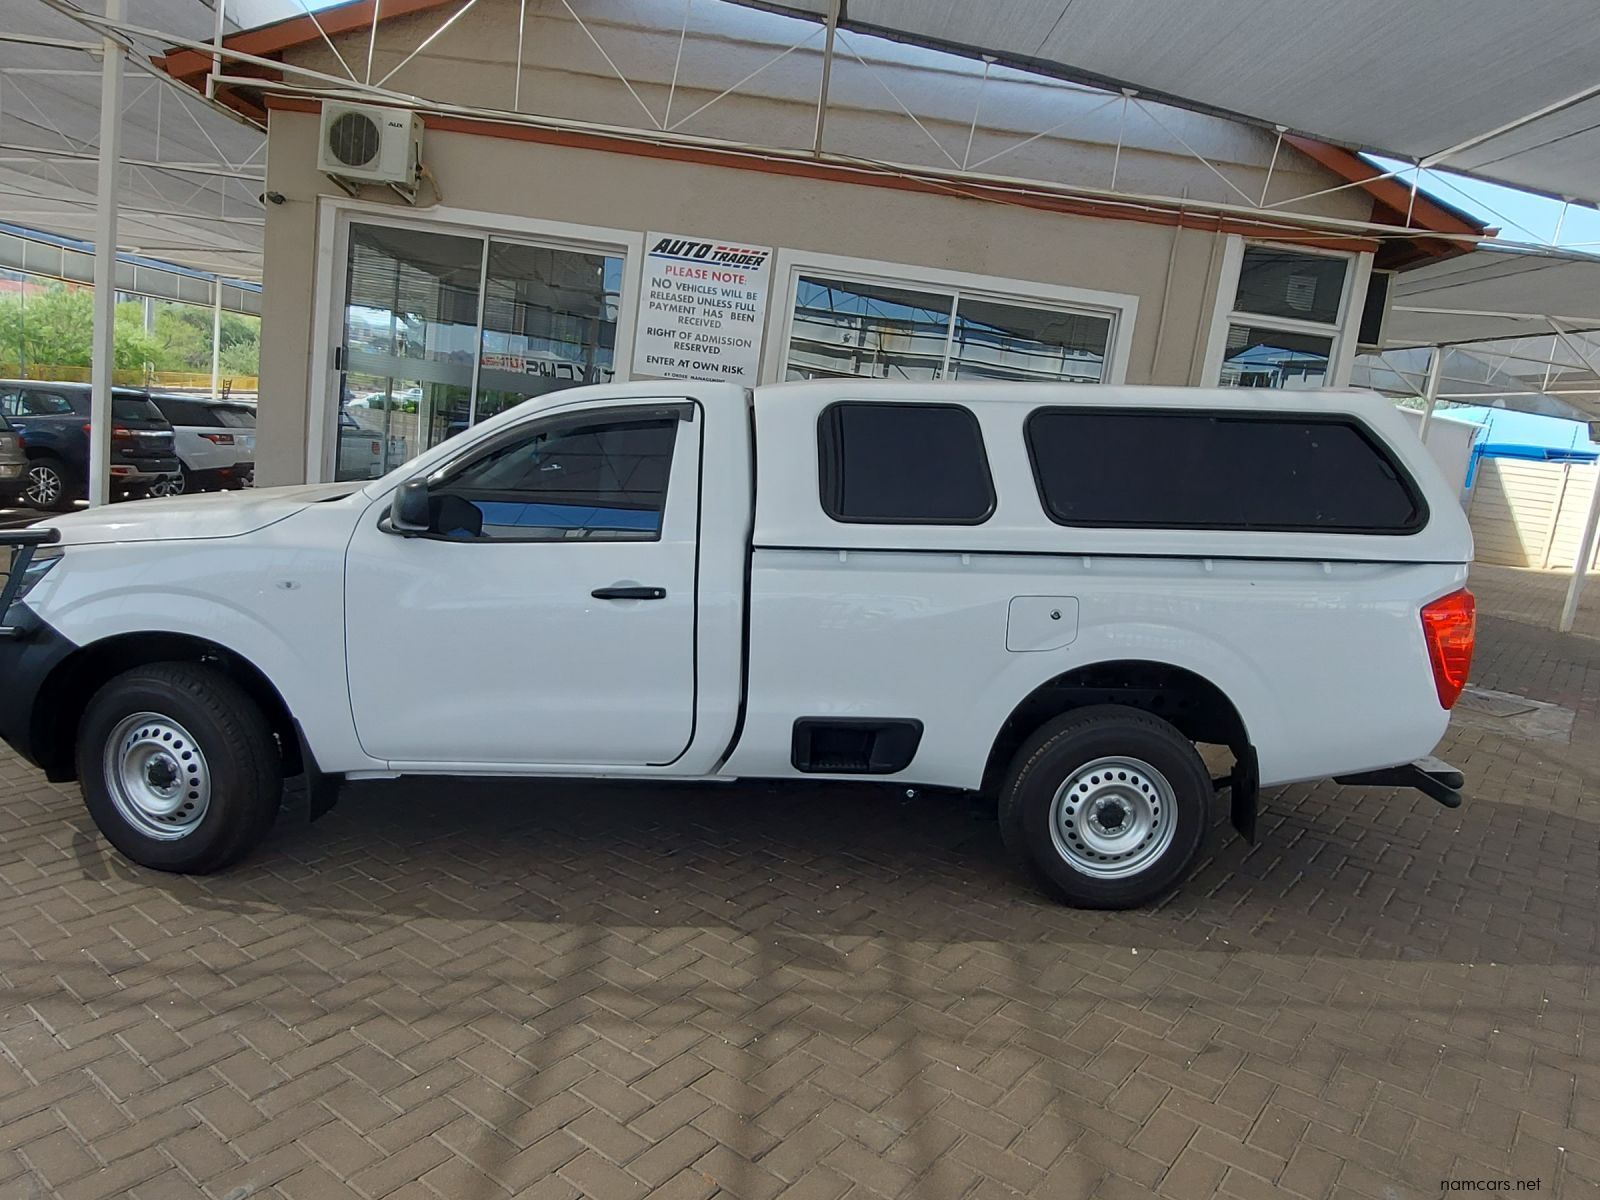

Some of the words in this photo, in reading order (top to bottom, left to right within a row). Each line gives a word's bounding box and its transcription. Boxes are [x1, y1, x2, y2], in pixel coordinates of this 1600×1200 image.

[652, 238, 713, 258] AUTO
[711, 251, 765, 266] TRADER
[665, 265, 708, 280] PLEASE
[712, 271, 747, 285] NOTE:
[651, 277, 672, 289] NO
[675, 282, 718, 295] VEHICLES
[721, 288, 743, 299] WILL
[746, 292, 758, 301] BE
[650, 290, 694, 304] RELEASED
[697, 297, 732, 309] UNLESS
[735, 301, 756, 312] FULL
[649, 301, 697, 315] PAYMENT
[703, 308, 723, 318] HAS
[731, 312, 755, 323] BEEN
[678, 316, 722, 329] RECEIVED
[647, 327, 676, 338] RIGHT
[679, 331, 693, 340] OF
[694, 333, 752, 348] ADMISSION
[673, 341, 721, 355] RESERVED
[646, 355, 675, 366] ENTER
[677, 359, 690, 368] AT
[692, 361, 719, 372] OWN
